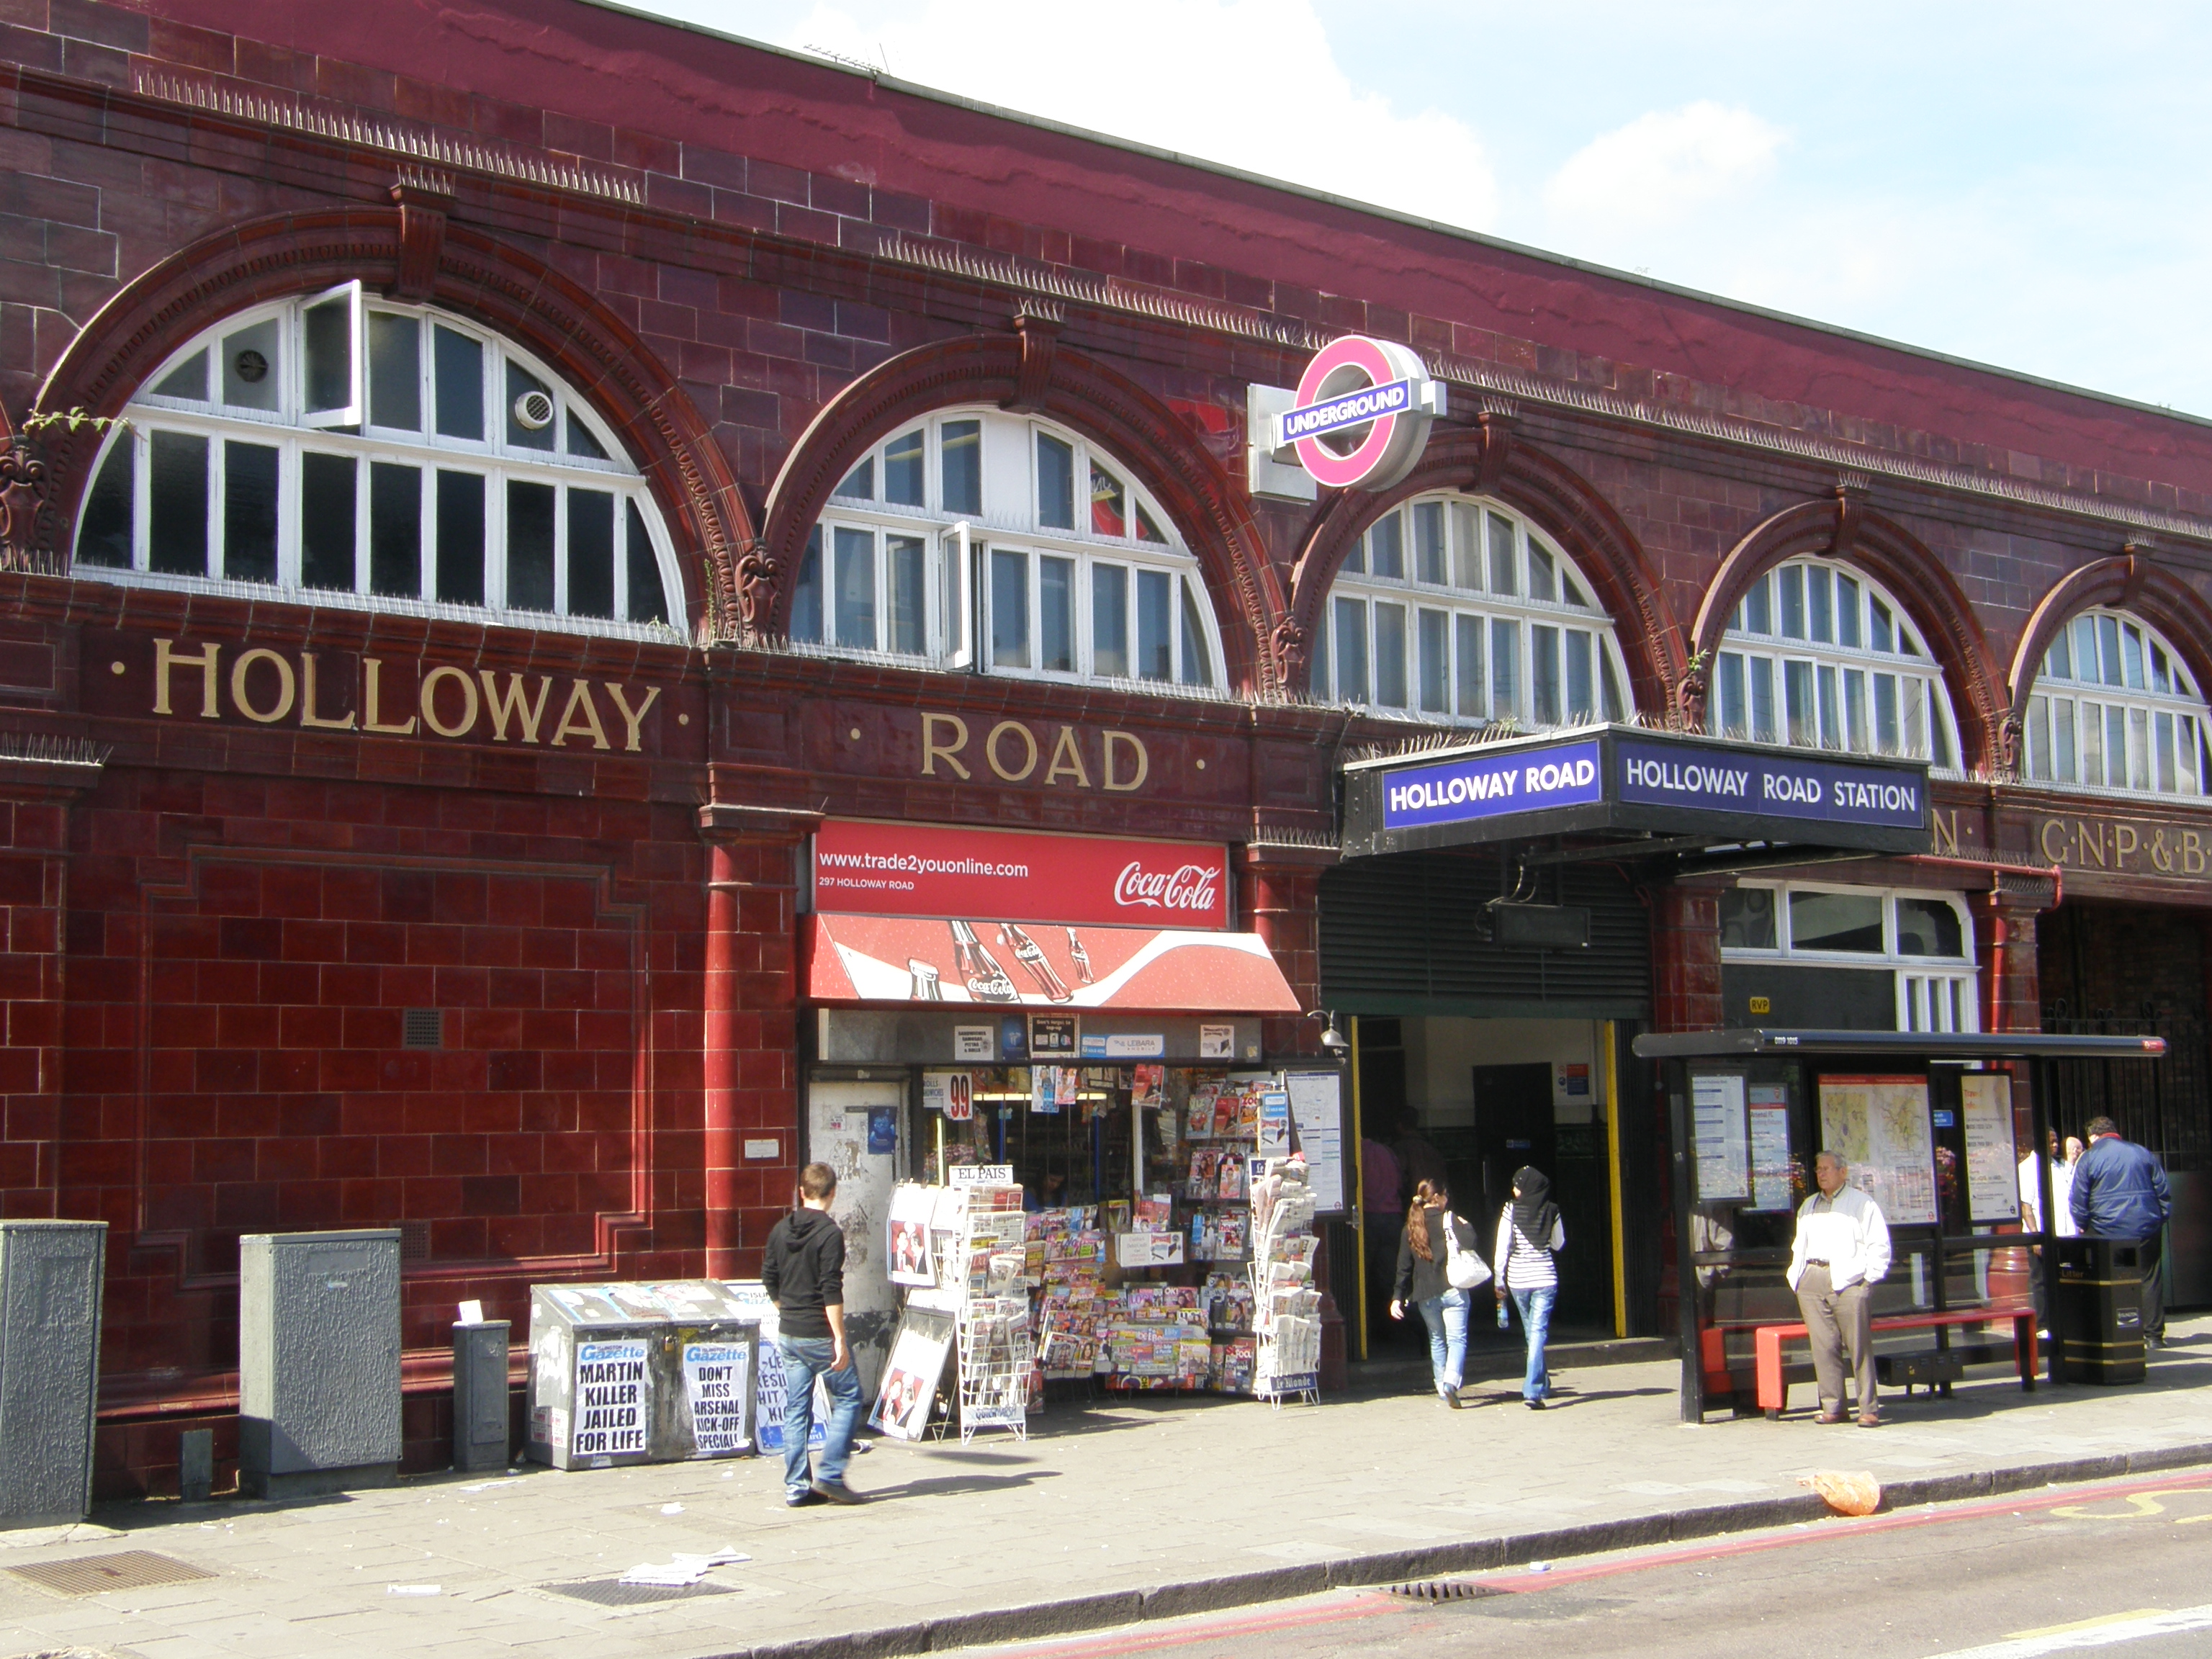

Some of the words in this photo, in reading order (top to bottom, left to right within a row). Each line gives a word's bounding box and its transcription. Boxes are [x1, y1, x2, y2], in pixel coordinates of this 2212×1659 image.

[1286, 387, 1405, 435] UNDERGROUND
[152, 638, 661, 752] HOLLOWAY
[920, 712, 1149, 791] ROAD
[1390, 770, 1518, 812] HOLLOWAY
[1525, 760, 1595, 793] ROAD
[1627, 758, 1749, 796] HOLLOWAY
[1763, 773, 1822, 804] ROAD
[1834, 781, 1915, 811] STATION
[819, 853, 1028, 877] www.trade2youonline.com
[819, 877, 835, 886] 297
[837, 878, 887, 889] HOLLOWAY
[889, 881, 914, 891] ROAD
[1114, 861, 1221, 910] Coca-Cola
[967, 976, 1016, 998] Coca-Cola
[1751, 999, 1768, 1010] RVP
[950, 1074, 970, 1118] 99
[958, 1168, 976, 1179] EL
[978, 1168, 1006, 1179] PAIS
[2062, 1270, 2084, 1279] Litter
[581, 1344, 644, 1361] Gazette
[686, 1346, 747, 1362] Gazette
[580, 1361, 643, 1384] MARTIN
[698, 1366, 733, 1381] DON'T
[1276, 1378, 1284, 1390] Le
[1285, 1376, 1311, 1389] Monde
[585, 1385, 637, 1407] KILLER
[702, 1383, 730, 1399] MISS
[583, 1407, 637, 1430] JAILED
[694, 1400, 739, 1416] ARSENAL
[696, 1416, 740, 1432] KICK-OFF
[576, 1431, 607, 1453] FOR
[611, 1429, 644, 1450] LIFE
[697, 1434, 738, 1449] SPECIAL!
